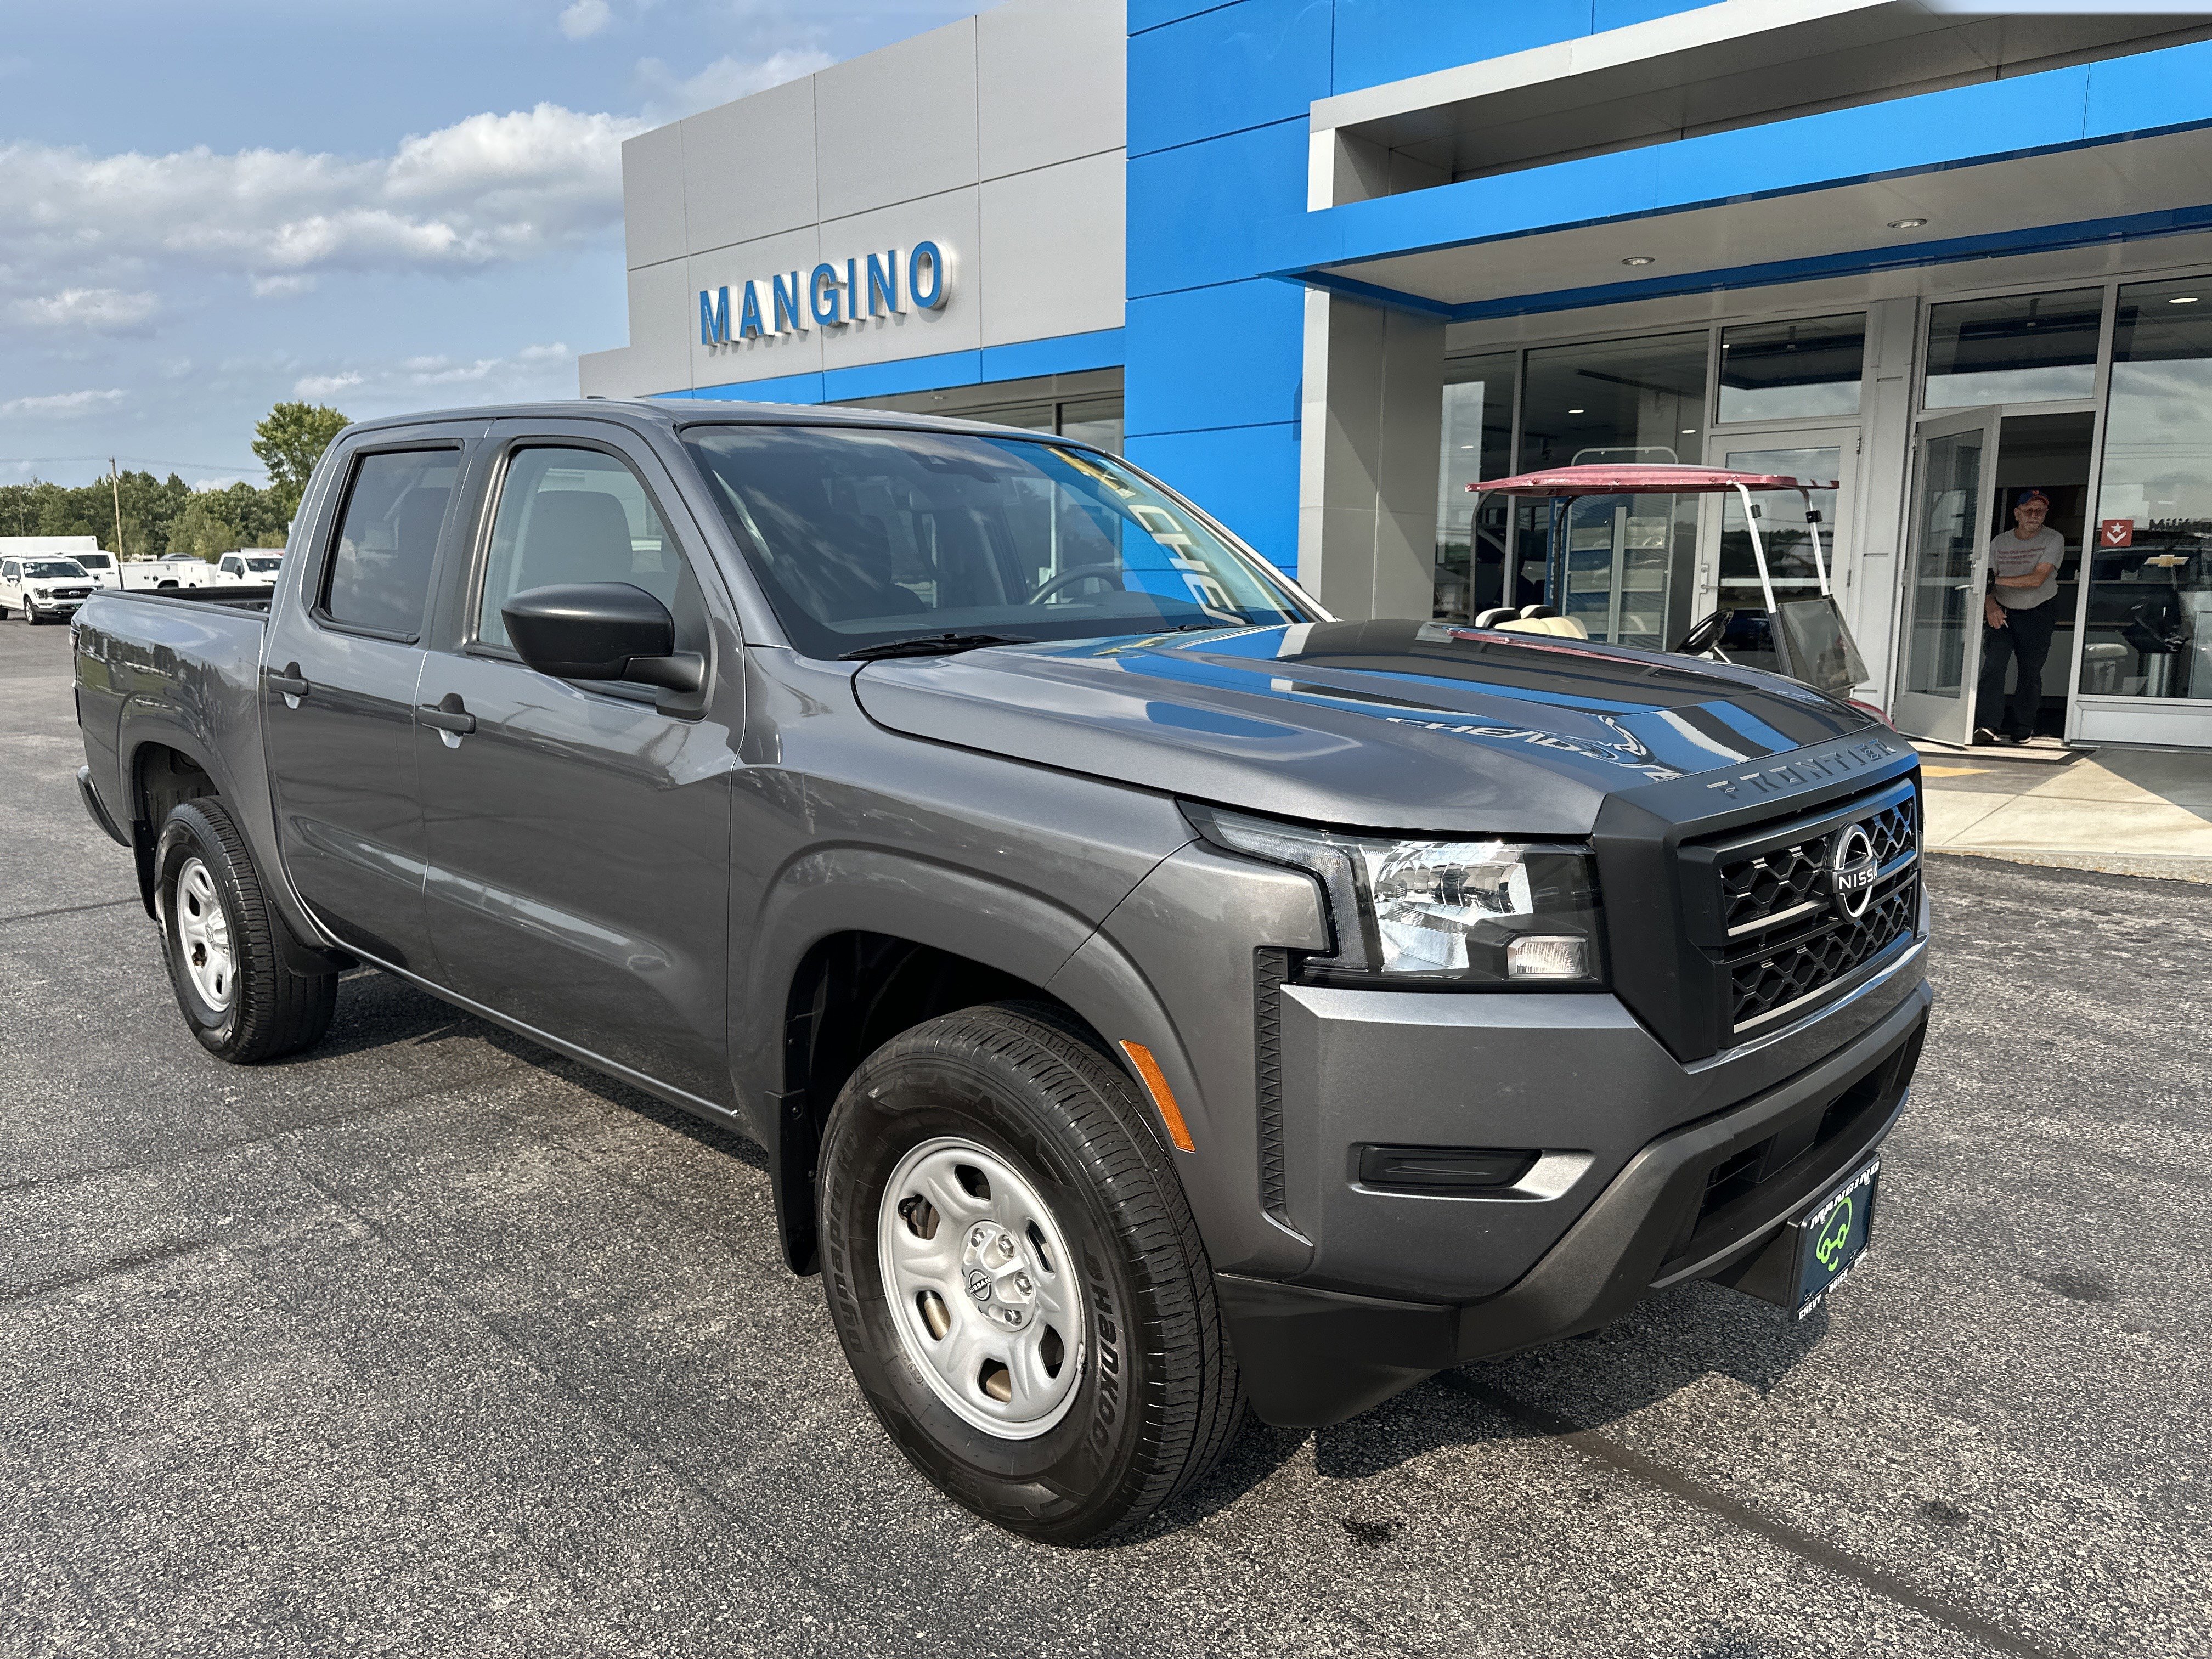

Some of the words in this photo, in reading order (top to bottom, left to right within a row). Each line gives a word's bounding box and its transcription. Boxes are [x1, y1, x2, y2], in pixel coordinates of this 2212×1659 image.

[700, 241, 948, 346] MANGINO
[1707, 739, 1897, 799] FRONTIER
[1838, 864, 1878, 890] NISSA
[1810, 1161, 1880, 1229] MANGINO
[969, 1277, 991, 1293] NISSAN
[1798, 1293, 1821, 1321] CHEVY
